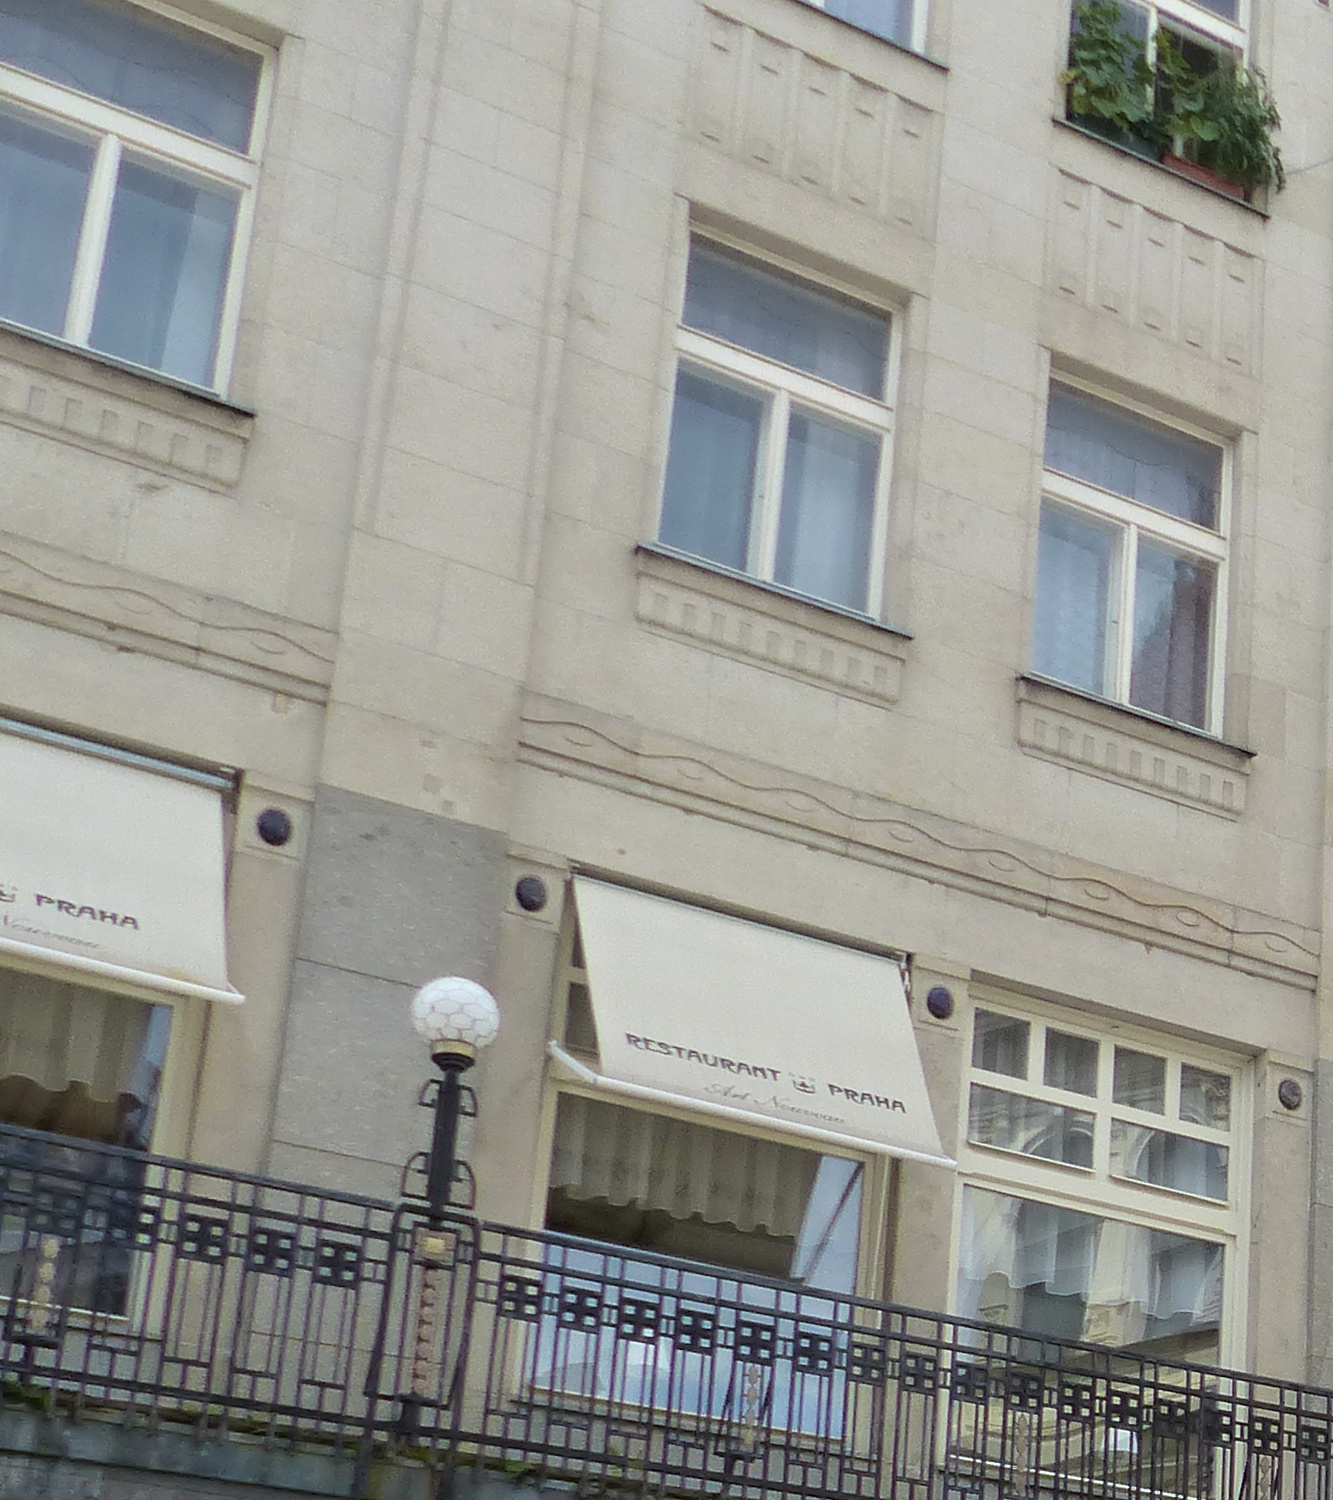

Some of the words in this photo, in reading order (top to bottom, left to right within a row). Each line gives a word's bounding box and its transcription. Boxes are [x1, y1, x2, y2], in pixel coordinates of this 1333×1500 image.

[34, 893, 140, 931] PRAHA
[625, 1032, 781, 1082] RESTAURANT
[828, 1083, 907, 1114] PRAHA
